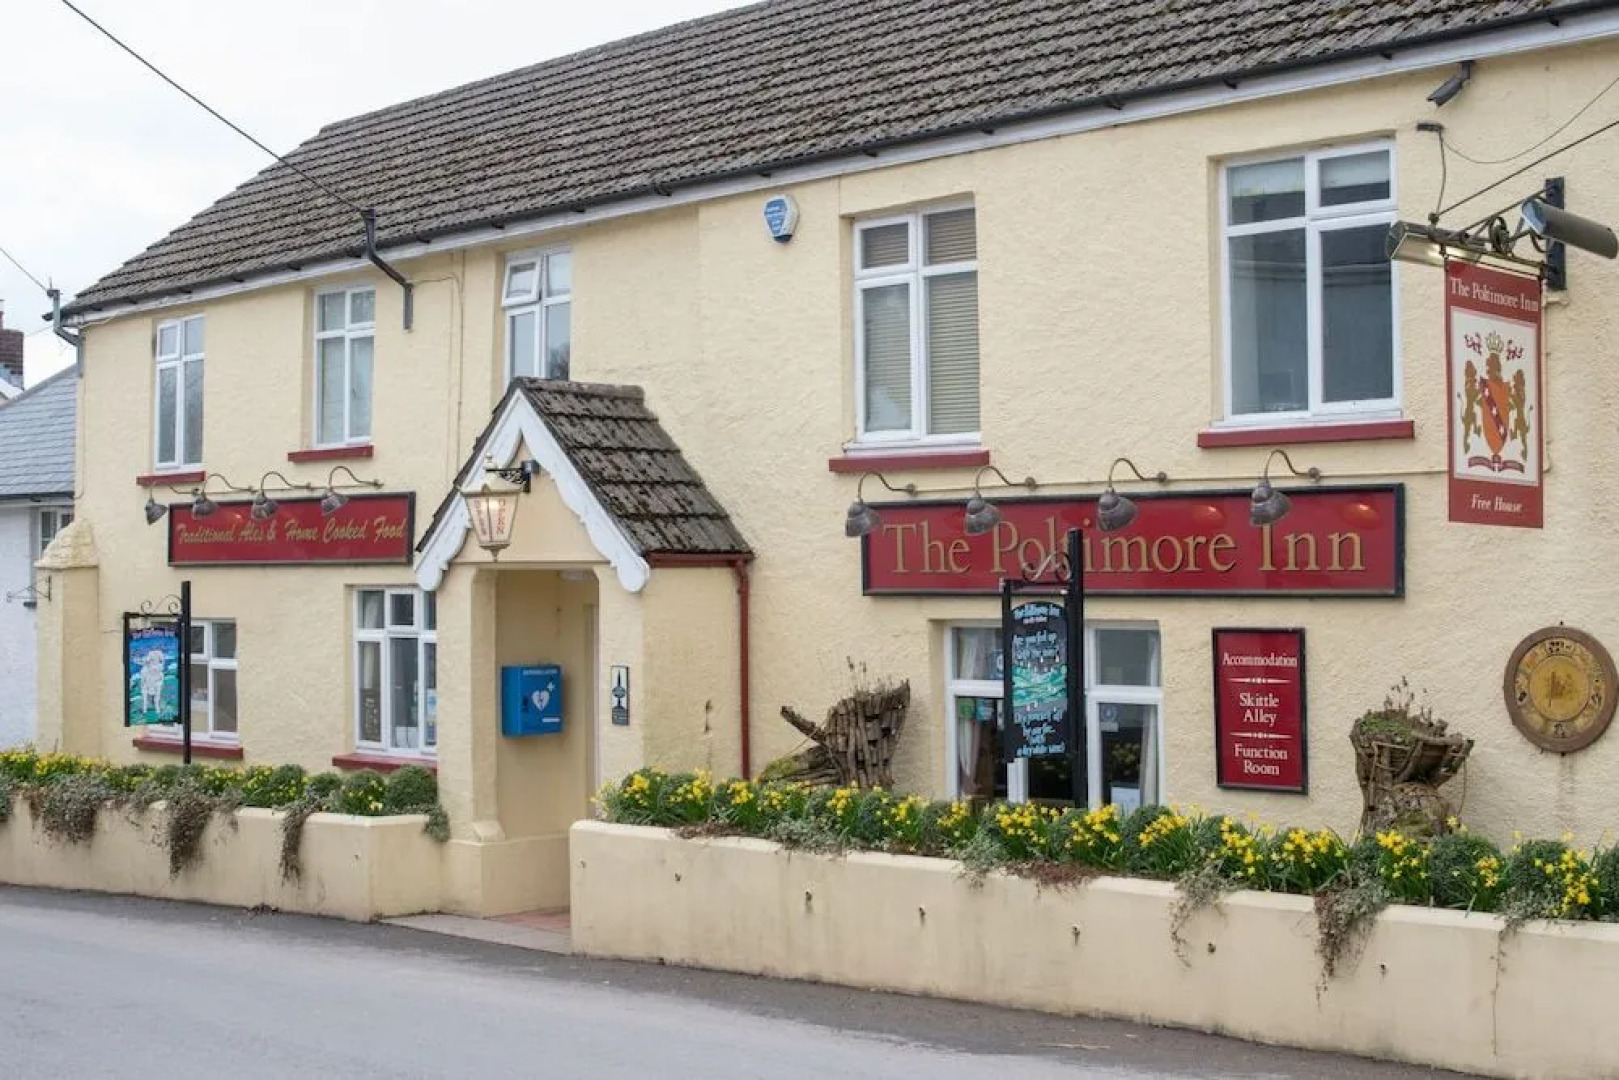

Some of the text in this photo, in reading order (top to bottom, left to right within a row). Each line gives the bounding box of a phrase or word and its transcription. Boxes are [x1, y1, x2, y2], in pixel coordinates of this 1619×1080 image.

[1450, 276, 1470, 298] The
[1520, 293, 1539, 312] Inn
[1471, 493, 1522, 514] Free House
[176, 521, 234, 546] Traditional
[238, 521, 262, 544] Ales
[284, 518, 319, 543] Home
[323, 517, 367, 545] Cooked
[373, 515, 407, 545] Food
[883, 518, 971, 574] The
[1258, 521, 1366, 573] Inn
[1222, 652, 1298, 668] Accommodation
[1239, 692, 1280, 707] Skittle
[1242, 709, 1277, 727] Alley
[1234, 743, 1288, 760] Function
[1243, 760, 1280, 775] Room
